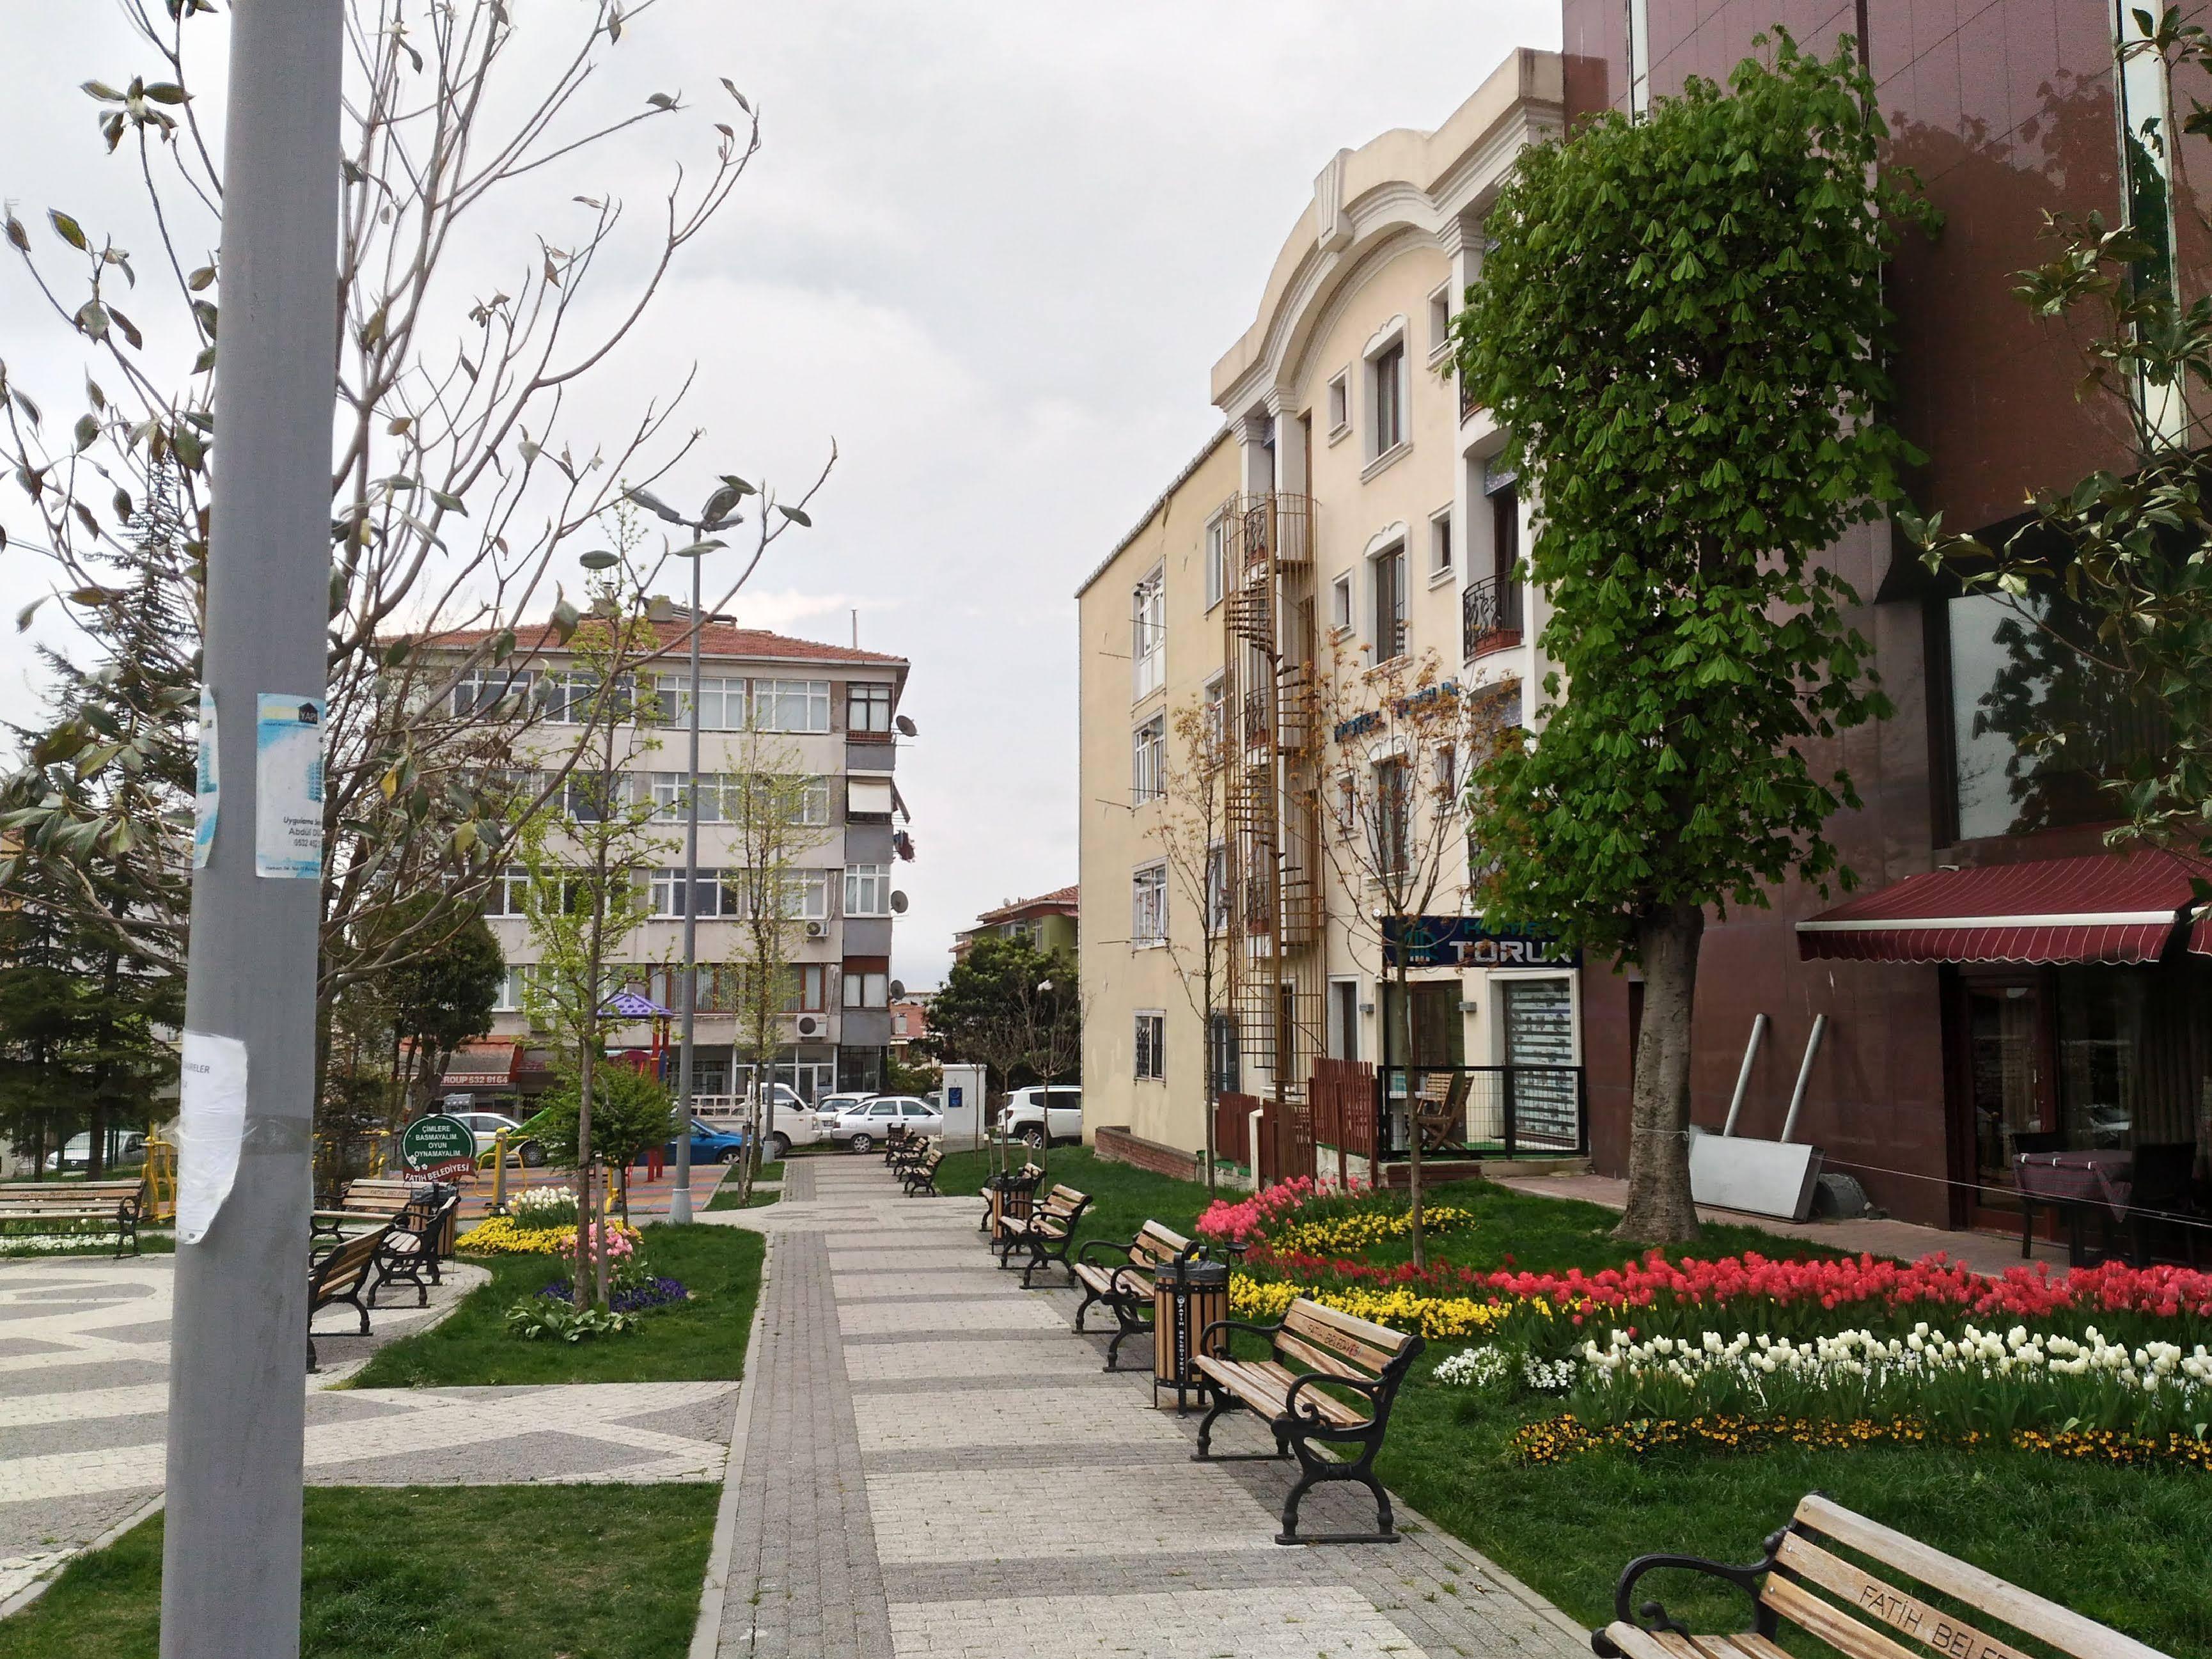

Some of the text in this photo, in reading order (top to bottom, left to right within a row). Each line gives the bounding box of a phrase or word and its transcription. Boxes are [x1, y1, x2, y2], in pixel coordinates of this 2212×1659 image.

[441, 1075, 468, 1084] ROUP
[422, 1124, 450, 1133] ÇİMLERE
[428, 1163, 469, 1181] BELEDİYESİ
[1860, 1585, 1924, 1633] FATİH
